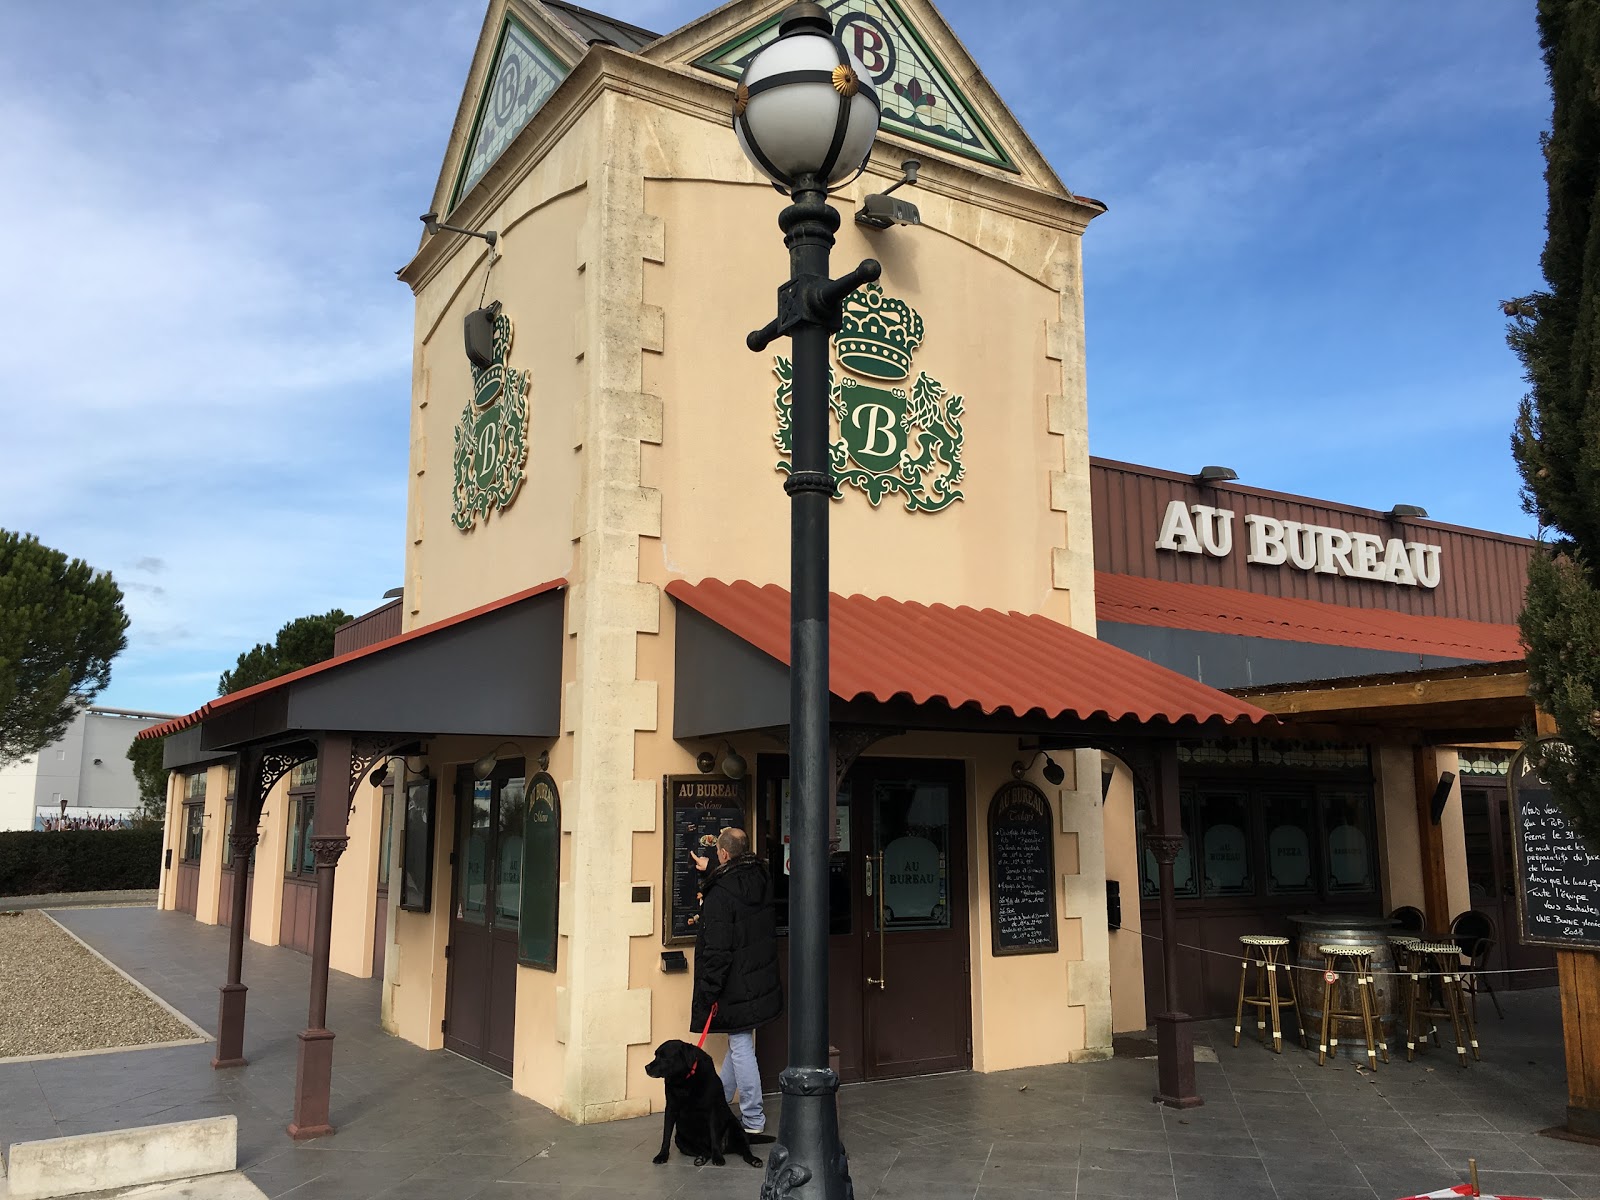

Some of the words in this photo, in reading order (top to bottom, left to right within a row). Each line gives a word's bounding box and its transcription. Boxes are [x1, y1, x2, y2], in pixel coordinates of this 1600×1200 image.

[847, 22, 885, 72] B
[851, 403, 904, 457] B
[479, 422, 497, 478] B
[1155, 500, 1235, 558] AU
[1245, 514, 1442, 590] BUREAU
[678, 783, 694, 797] AU
[696, 783, 738, 797] BUREAU
[998, 790, 1011, 815] AU
[1012, 787, 1044, 816] BUREAU
[1552, 830, 1562, 840] le
[1277, 847, 1304, 857] PIZZA
[905, 861, 920, 872] AU
[1528, 864, 1538, 872] de
[889, 874, 935, 885] BUREAU
